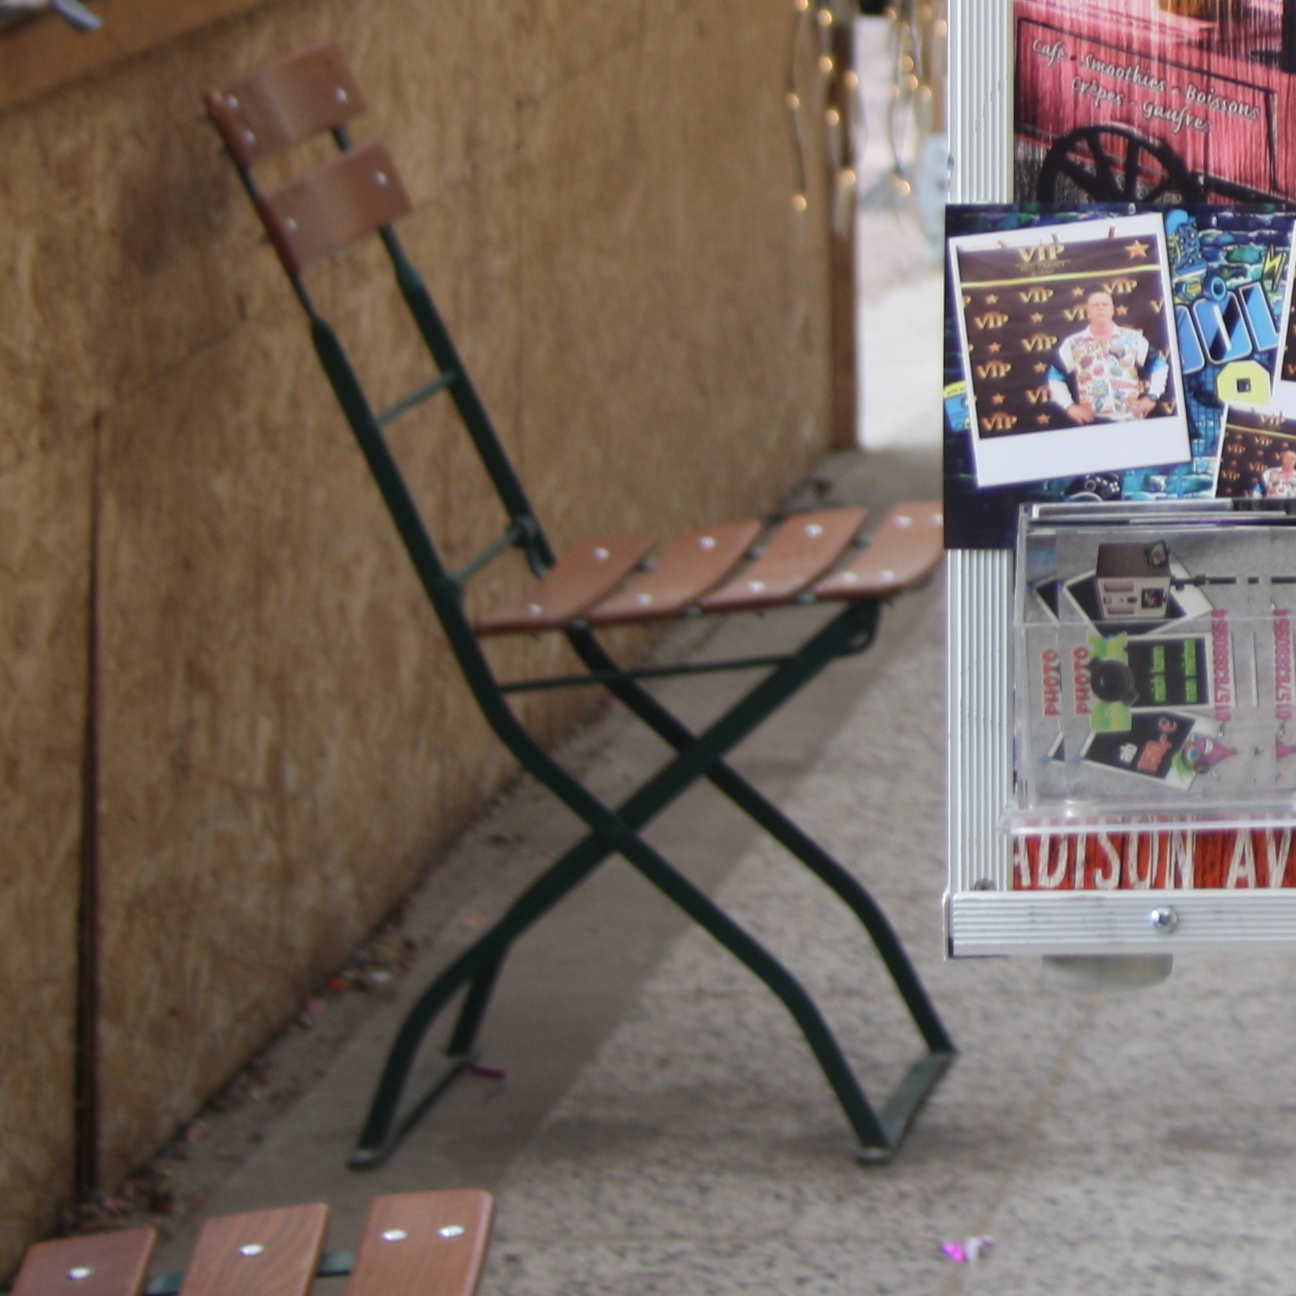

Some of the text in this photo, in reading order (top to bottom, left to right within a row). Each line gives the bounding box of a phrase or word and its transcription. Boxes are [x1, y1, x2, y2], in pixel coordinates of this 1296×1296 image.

[1080, 53, 1166, 94] Smoothies
[1185, 84, 1261, 121] Boissons
[1143, 100, 1213, 134] Gaufres
[1017, 243, 1065, 264] VIP
[1018, 288, 1054, 304] VIP
[1103, 279, 1138, 296] VIP
[974, 313, 1009, 330] VIP
[1063, 304, 1087, 322] VI
[1021, 336, 1058, 352] VIP
[977, 363, 1012, 380] VIP
[1025, 389, 1050, 405] VI
[981, 415, 1018, 432] VIP
[1042, 648, 1060, 717] PHOTO
[1072, 646, 1091, 716] PHOTO
[1227, 816, 1293, 889] AV
